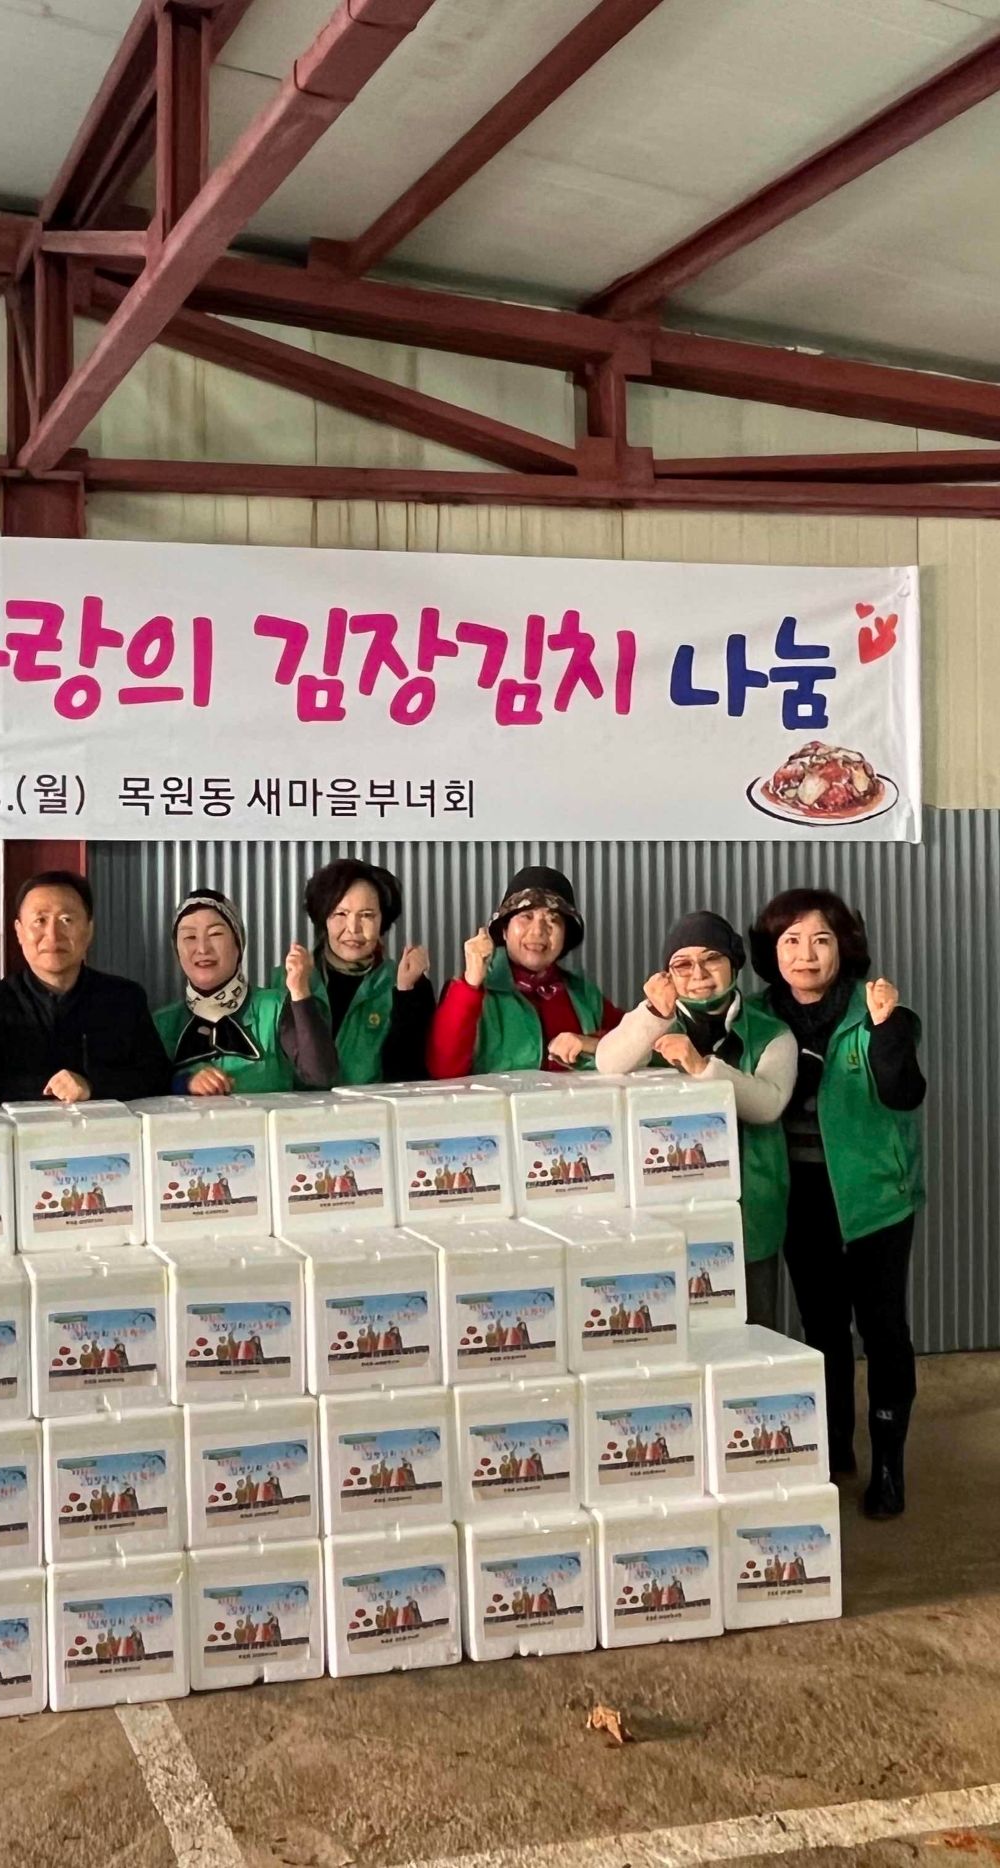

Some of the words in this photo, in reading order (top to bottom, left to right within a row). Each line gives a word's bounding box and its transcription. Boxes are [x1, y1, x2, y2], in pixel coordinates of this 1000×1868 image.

[254, 608, 636, 725] 김장김치
[671, 618, 836, 729] 나눔
[118, 777, 235, 817] 목원동
[246, 778, 475, 819] 새마을부녀회
